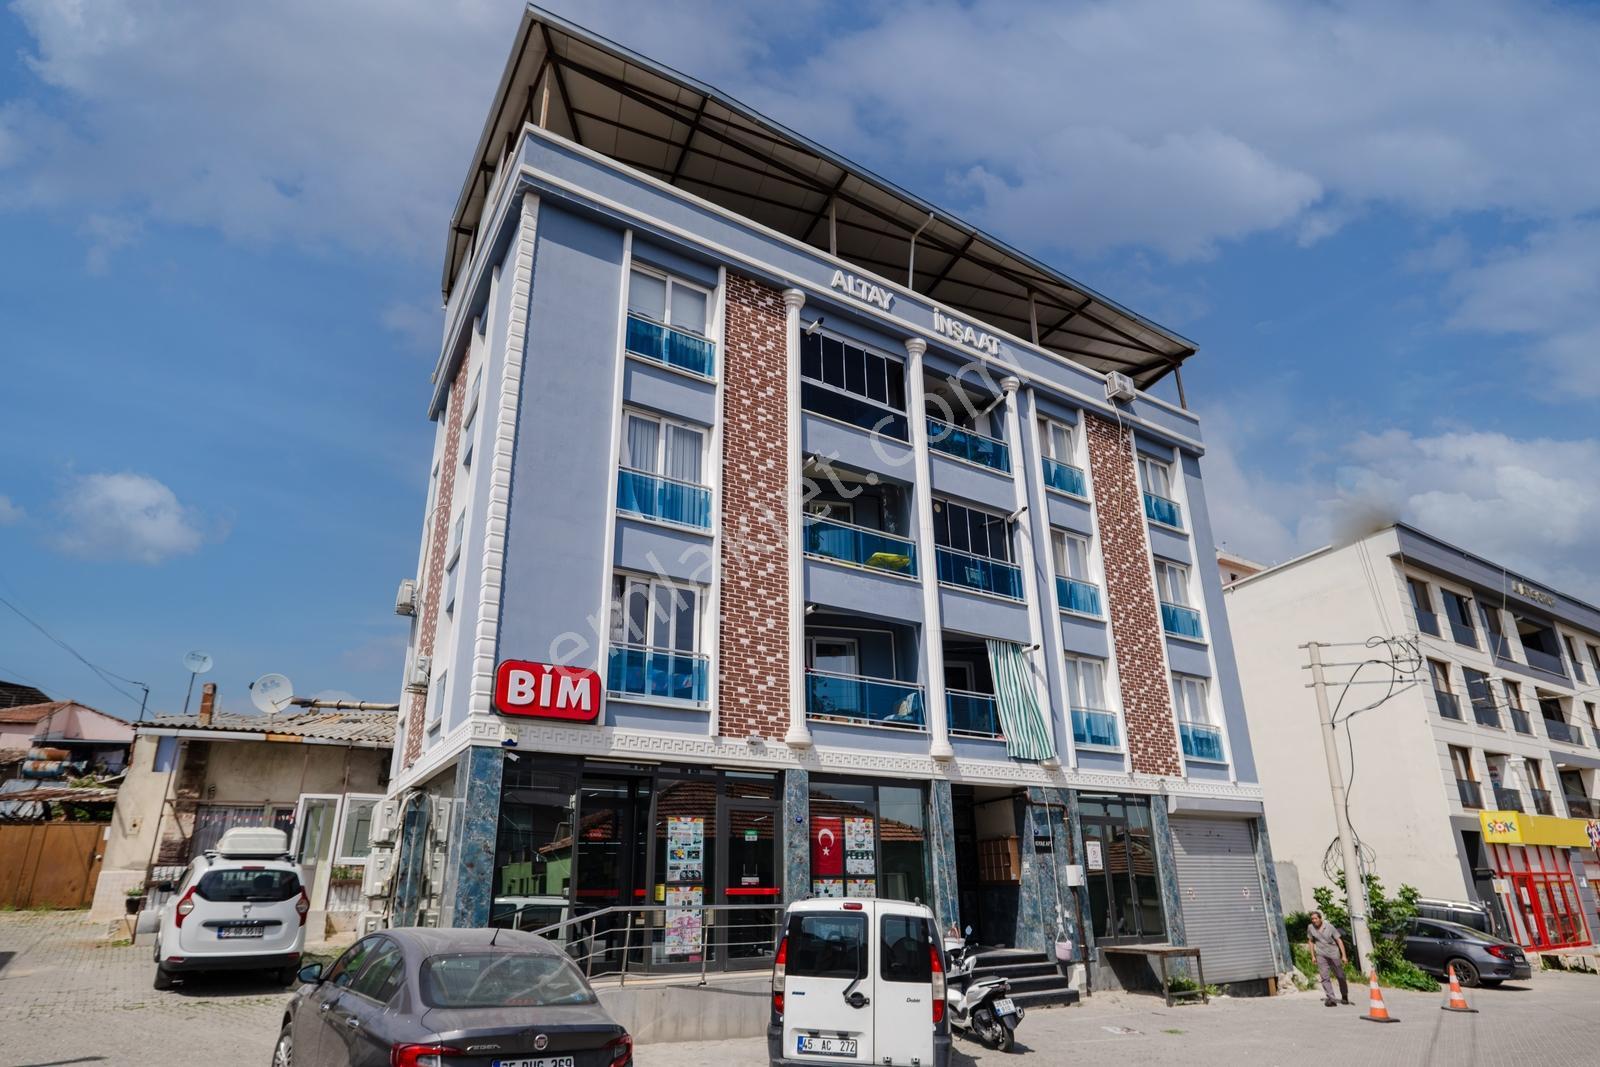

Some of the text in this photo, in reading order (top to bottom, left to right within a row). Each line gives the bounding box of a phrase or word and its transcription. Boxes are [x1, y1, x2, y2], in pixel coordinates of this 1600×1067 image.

[831, 269, 1001, 356] ALTAY İNŞAAT
[507, 664, 592, 711] BİM
[803, 1039, 813, 1050] 45
[821, 1040, 832, 1051] AC
[840, 1041, 856, 1053] 272
